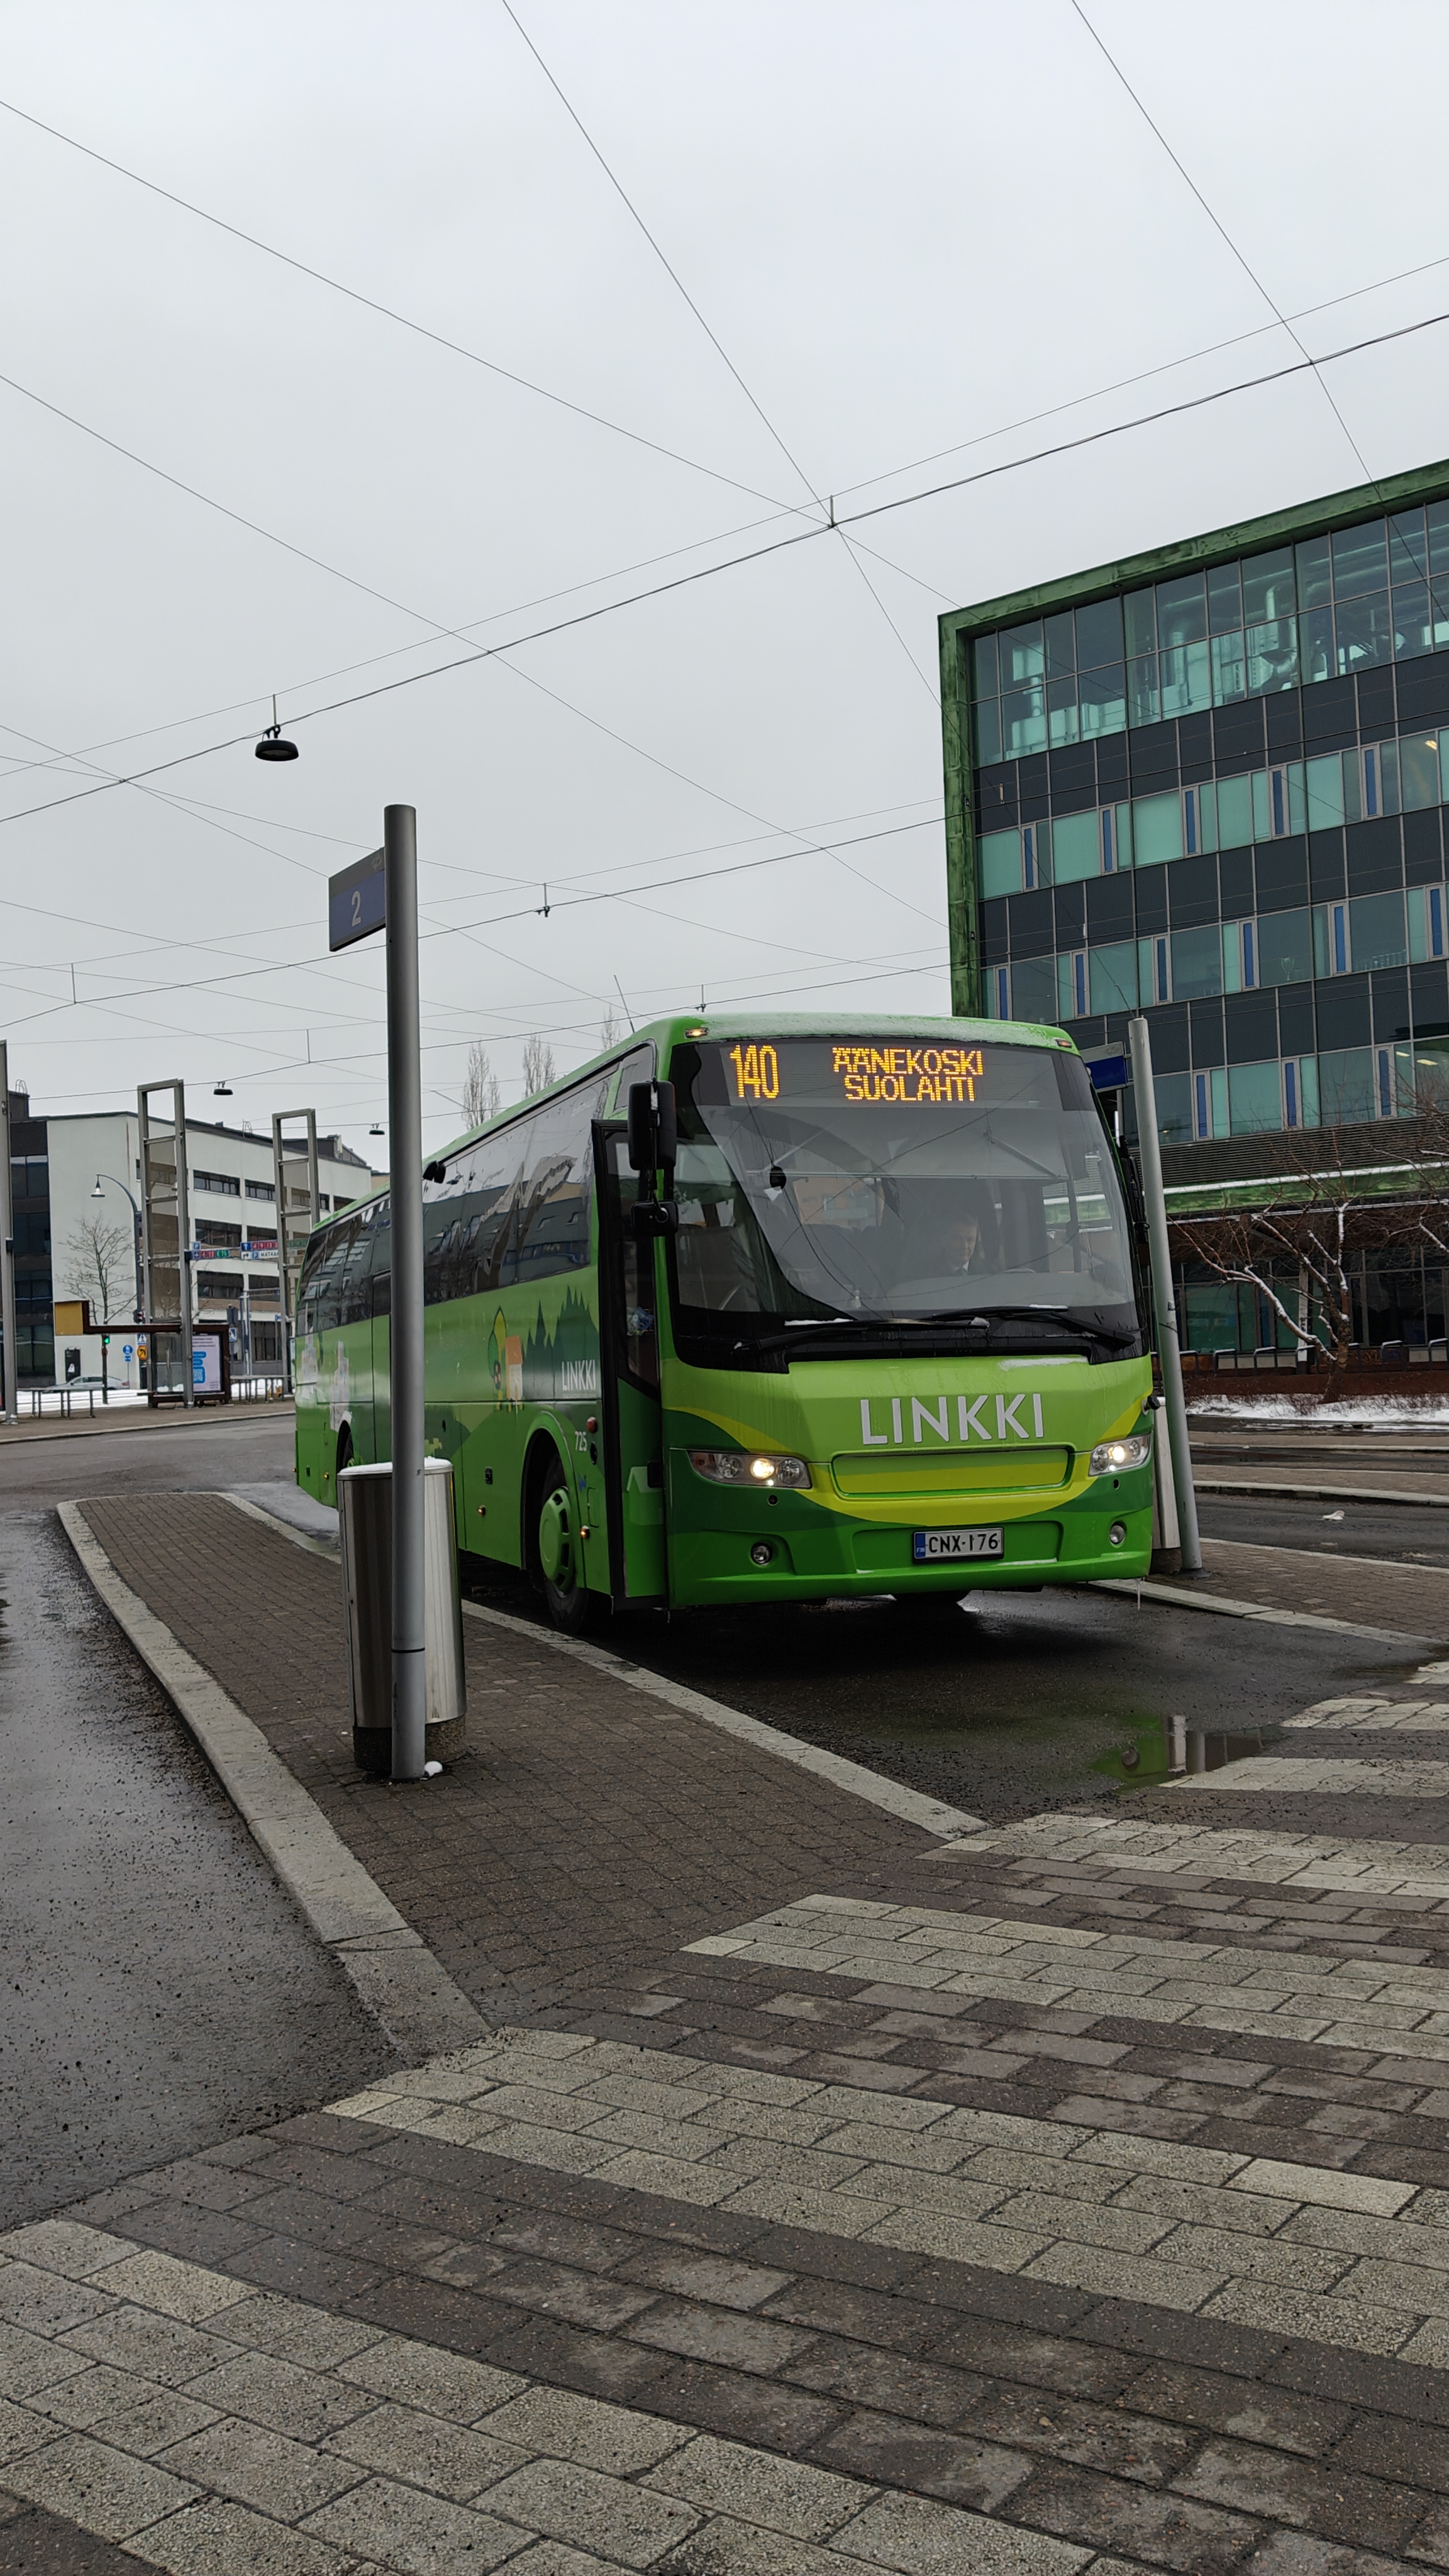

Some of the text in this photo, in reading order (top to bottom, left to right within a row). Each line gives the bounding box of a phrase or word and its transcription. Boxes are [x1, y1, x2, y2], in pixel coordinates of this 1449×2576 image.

[352, 891, 362, 927] 2
[730, 1045, 779, 1099] 140
[832, 1047, 984, 1075] ÄÄNEKOSKI
[843, 1074, 975, 1101] SUOLAHTI
[562, 1360, 596, 1391] LINKKI
[860, 1394, 1044, 1445] LINKKI
[575, 1431, 587, 1452] 725
[929, 1533, 998, 1553] CNX-176
